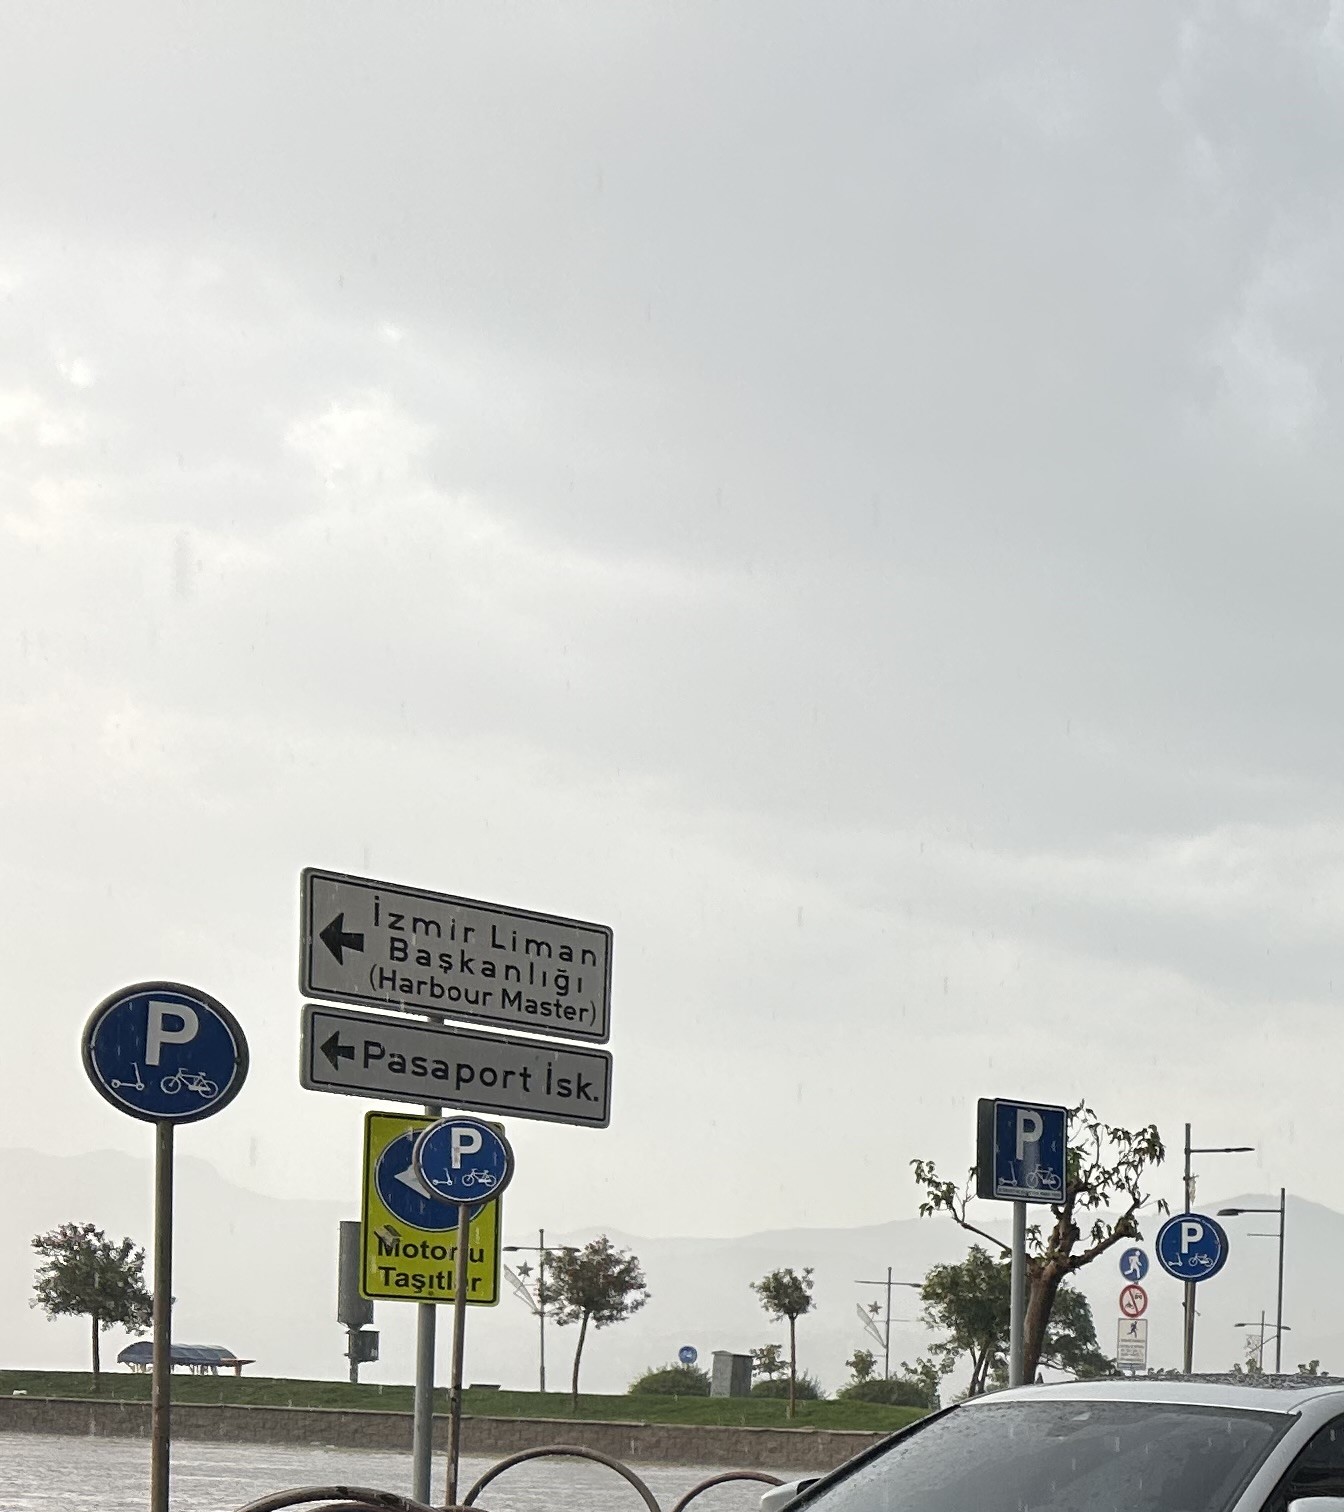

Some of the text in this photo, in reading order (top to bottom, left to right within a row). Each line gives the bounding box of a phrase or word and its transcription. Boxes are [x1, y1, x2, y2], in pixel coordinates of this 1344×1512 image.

[373, 896, 596, 966] İzmir Liman
[389, 937, 582, 996] Başkanlığı
[369, 964, 598, 1027] (Harbour Master)
[146, 1000, 199, 1066] P
[363, 1040, 599, 1101] Pasaport İsk.
[452, 1127, 483, 1169] P
[1016, 1108, 1044, 1160] P
[378, 1237, 484, 1263] Motoru
[1181, 1222, 1204, 1254] P
[378, 1266, 482, 1293] Taşıtlr
